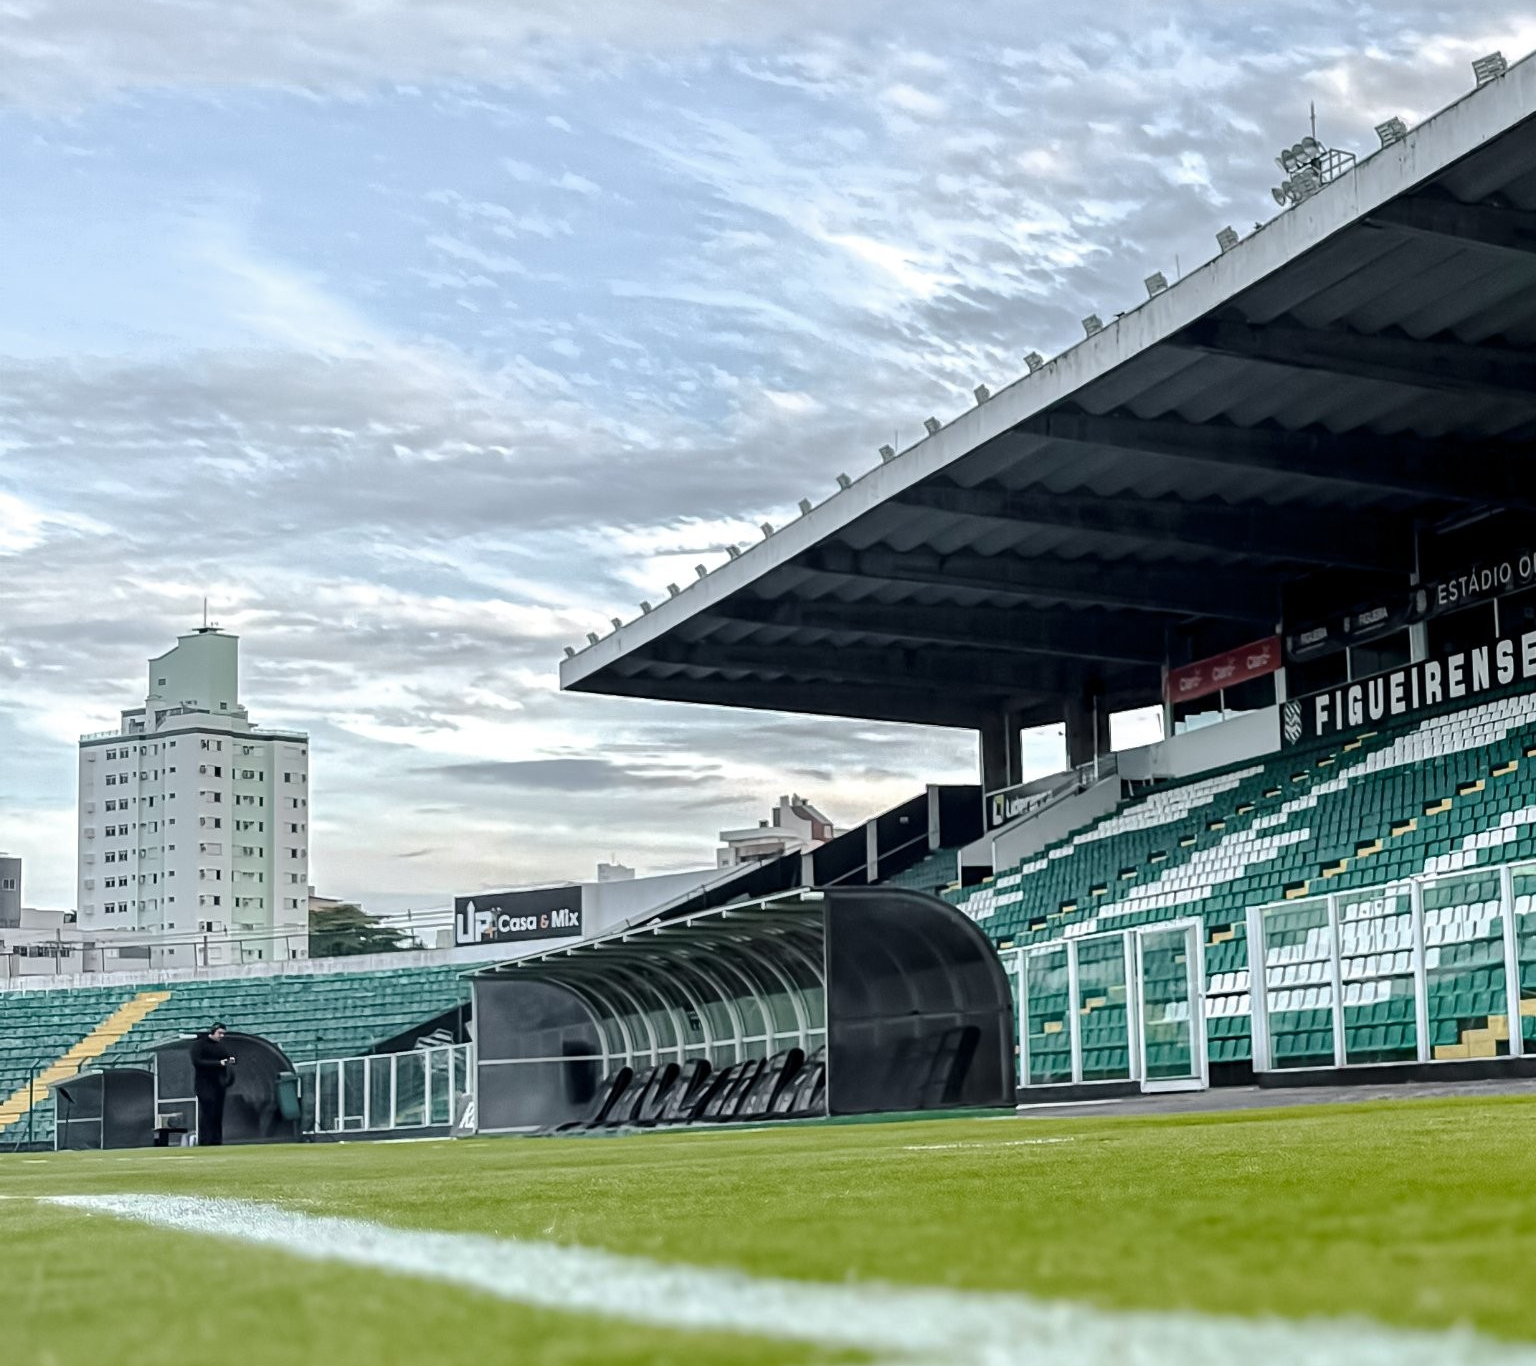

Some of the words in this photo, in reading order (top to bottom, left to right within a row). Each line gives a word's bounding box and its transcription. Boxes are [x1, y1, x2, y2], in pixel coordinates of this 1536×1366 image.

[1437, 561, 1512, 605] ESTÁDIO
[498, 914, 537, 933] Casa
[551, 908, 579, 928] Mix
